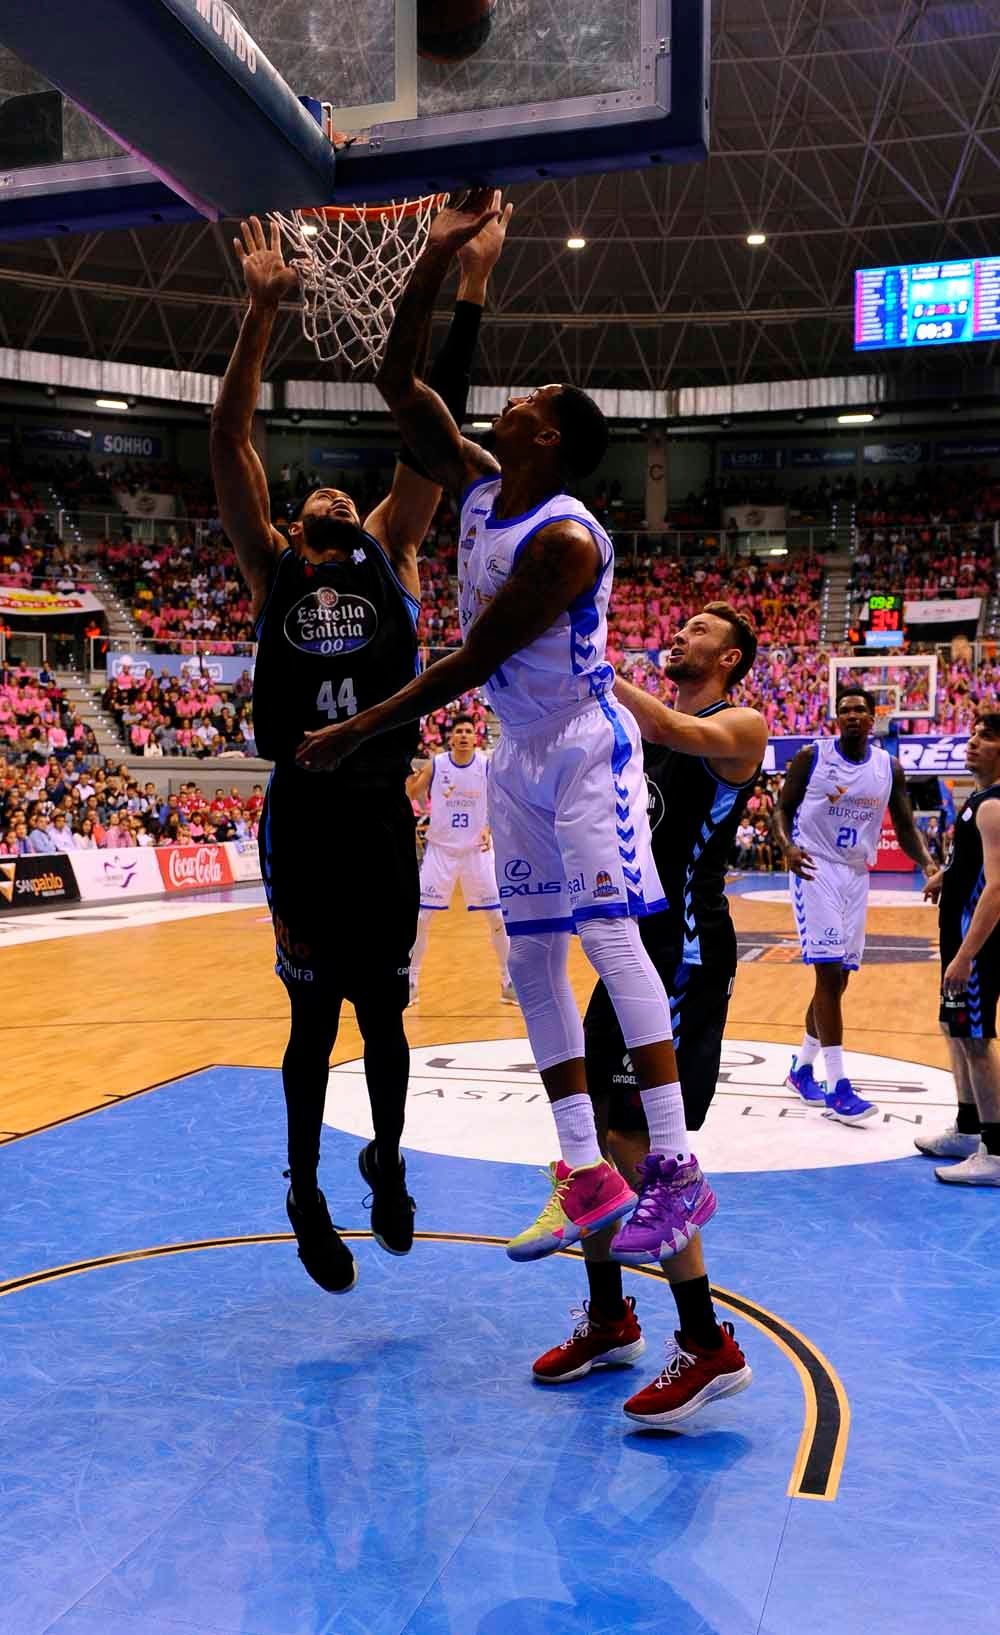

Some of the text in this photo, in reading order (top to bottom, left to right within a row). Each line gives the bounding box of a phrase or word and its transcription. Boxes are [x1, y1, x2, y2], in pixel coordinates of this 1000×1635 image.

[297, 605, 365, 624] Estrella
[301, 620, 363, 641] Galicia
[316, 677, 358, 719] 44
[452, 813, 469, 828] 23
[828, 806, 874, 821] BURGOS
[836, 827, 857, 848] 21
[741, 1105, 923, 1126] LEN
